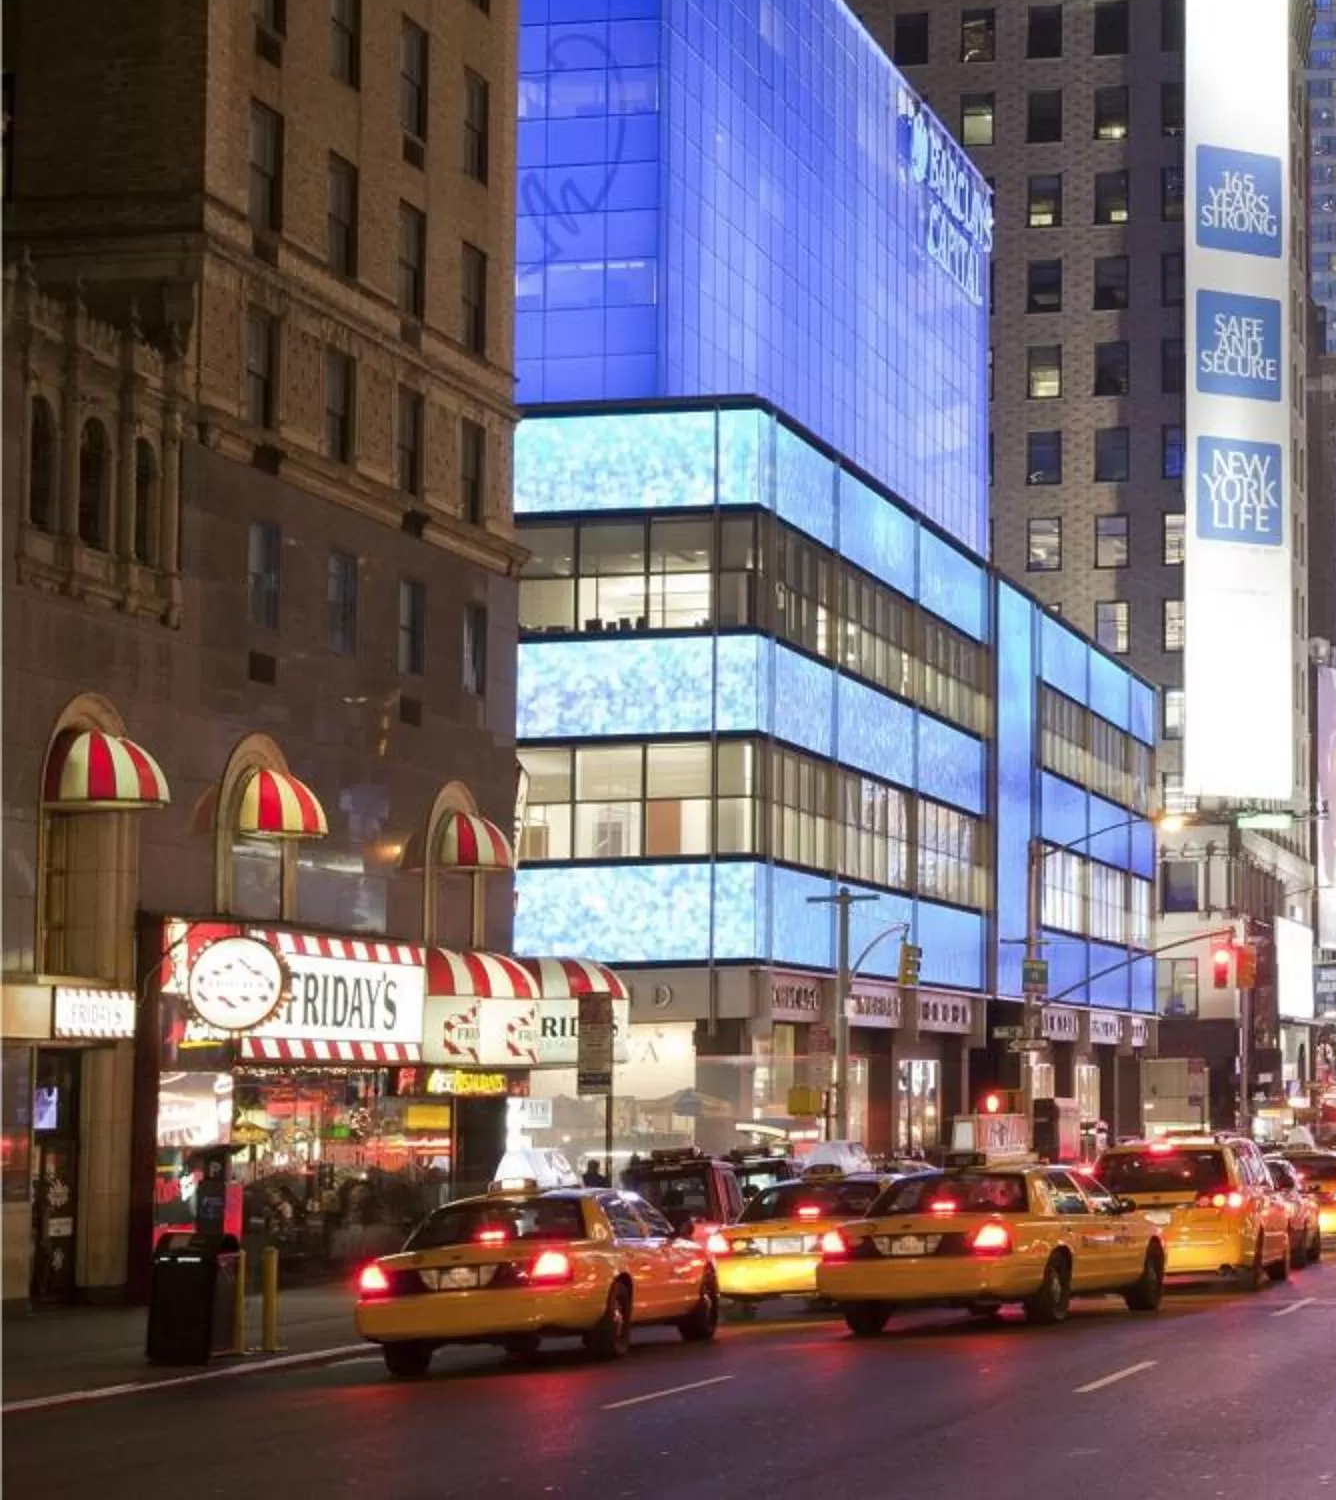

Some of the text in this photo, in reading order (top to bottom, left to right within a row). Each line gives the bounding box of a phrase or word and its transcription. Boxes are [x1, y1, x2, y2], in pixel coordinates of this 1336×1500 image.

[929, 127, 993, 253] BARCLAYS
[1222, 171, 1254, 194] 165
[1209, 187, 1269, 214] YEARS
[1201, 204, 1277, 237] STRONG
[928, 204, 982, 306] CAPITAL
[1214, 313, 1265, 340] SAFE
[1217, 336, 1262, 358] AND
[1201, 351, 1278, 380] SECURE
[1212, 449, 1271, 479] NEW
[1202, 474, 1278, 509] YORK
[1212, 503, 1270, 532] LIFE
[285, 971, 398, 1031] FRIDAY'S
